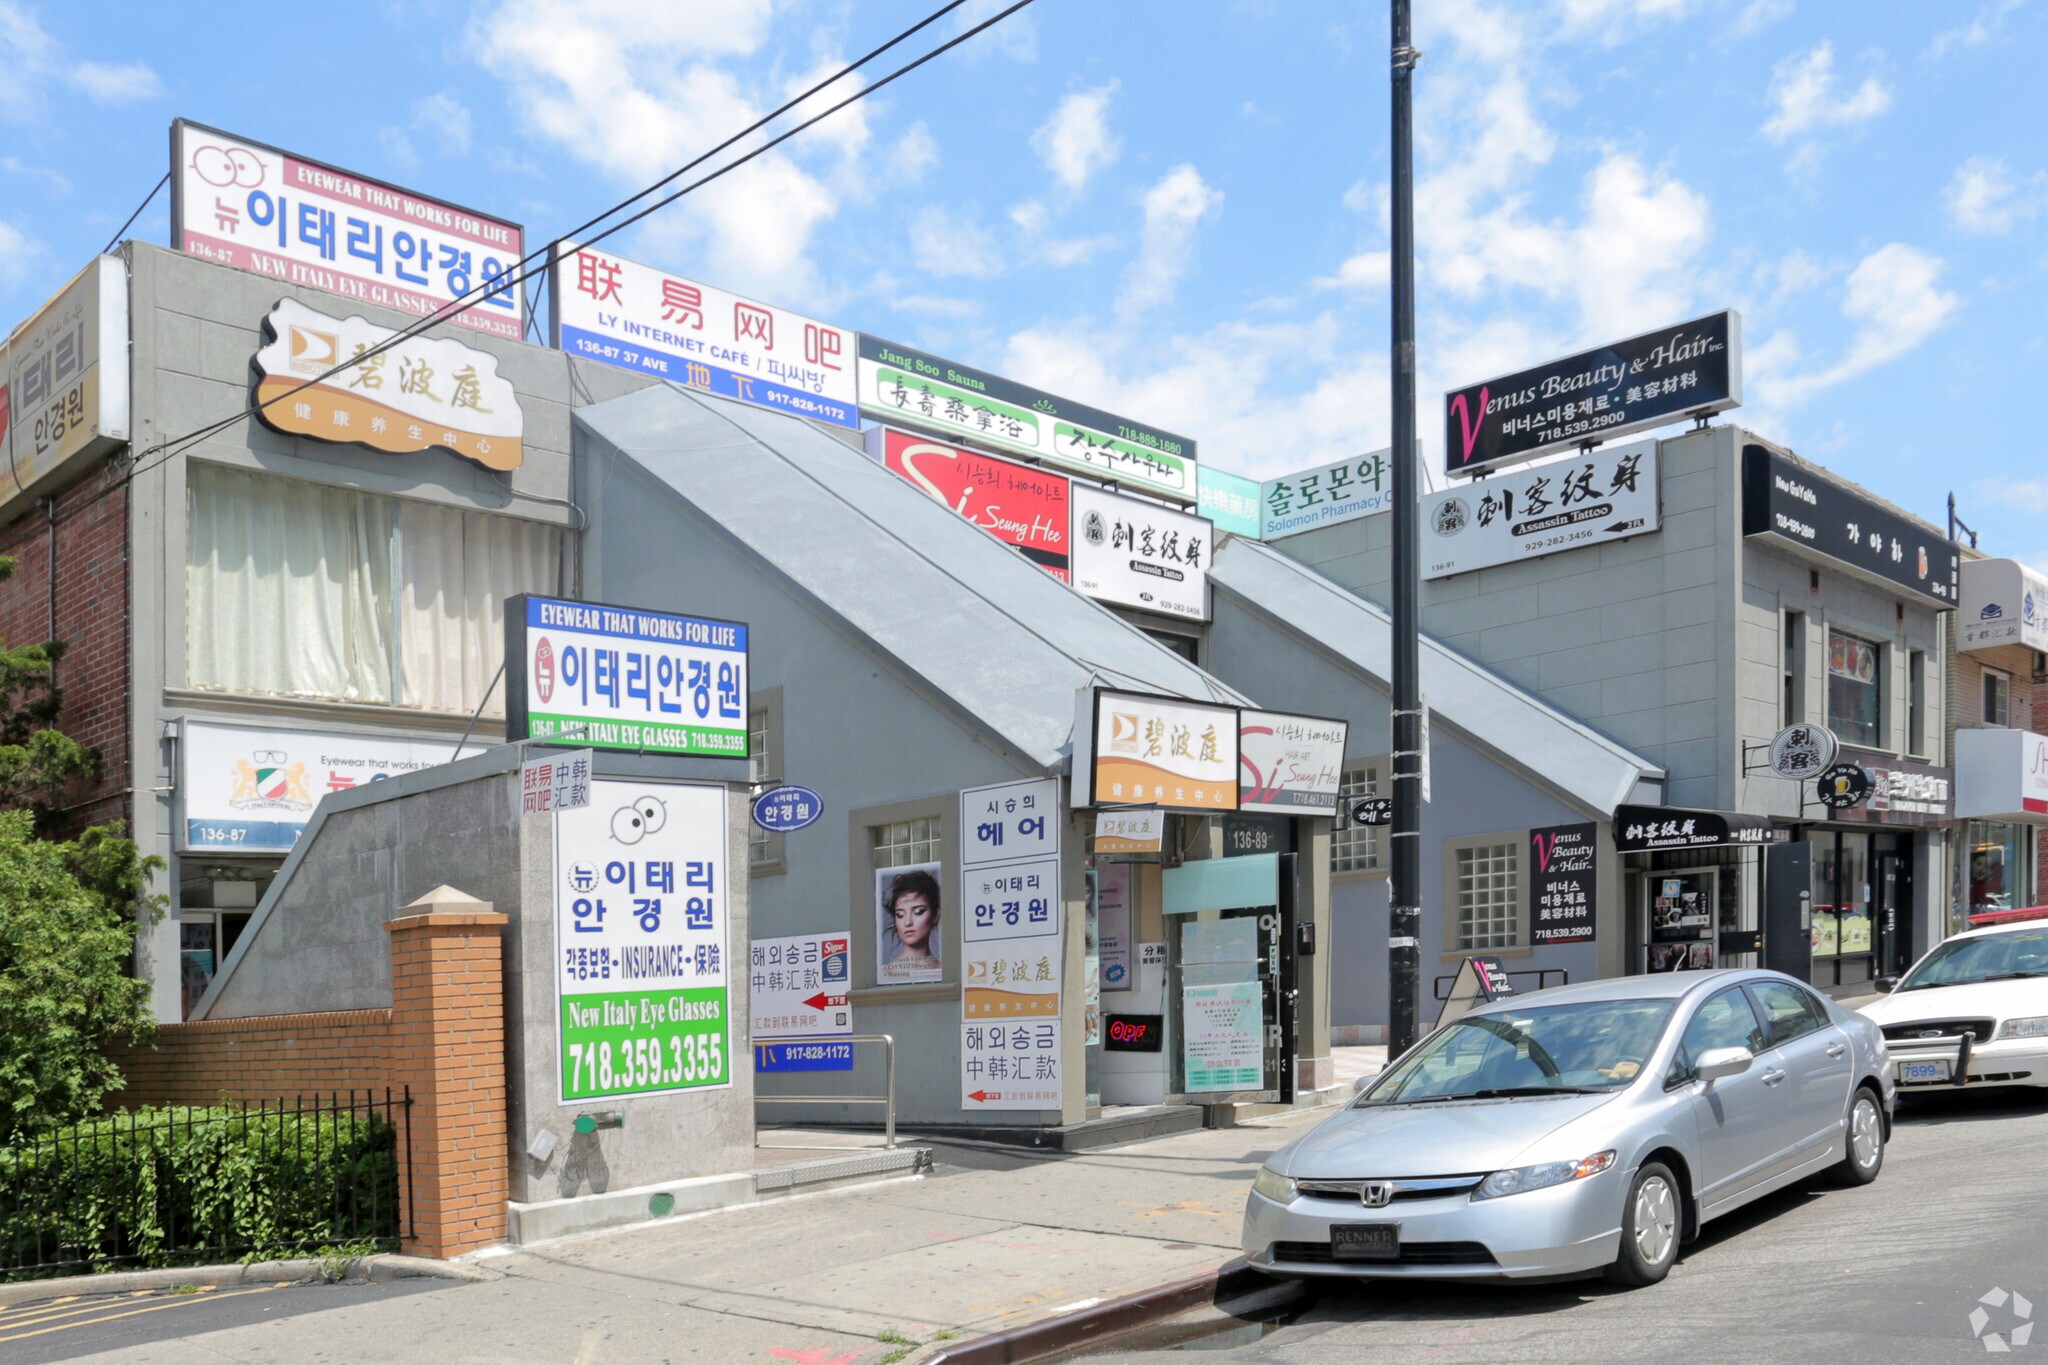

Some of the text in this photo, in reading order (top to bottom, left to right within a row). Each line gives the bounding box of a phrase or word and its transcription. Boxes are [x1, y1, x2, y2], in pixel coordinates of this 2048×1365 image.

[298, 165, 508, 244] EYEWEAR THAT WORKS FOR LIFE
[247, 190, 515, 310] 이태리안경원
[189, 240, 233, 263] 136-87
[250, 252, 287, 276] NEW
[292, 265, 335, 291] ITALY
[340, 277, 367, 299] EYE
[371, 286, 438, 320] GLASSES
[577, 250, 842, 371] 联易网吧
[598, 312, 618, 328] LY
[623, 319, 705, 352] INTERNET
[576, 339, 668, 373] 136-87 37 AVE
[879, 348, 985, 391] Jang Soo Sauna
[350, 342, 493, 414] 碧波庭
[767, 390, 845, 420] 917-828-1172
[1450, 386, 1536, 464] Venus
[1541, 362, 1626, 399] Beauty
[1650, 333, 1714, 368] Hair
[35, 382, 84, 456] 안경원
[1538, 411, 1625, 443] 718.539.2900
[1118, 425, 1181, 455] 718-888-1680
[1268, 455, 1392, 517] 솔로몬약
[979, 505, 1028, 542] Seung
[1030, 514, 1061, 543] Hee
[1267, 511, 1319, 533] Solomon
[1321, 495, 1382, 519] Pharmacy
[1518, 506, 1609, 535] Assassin Tattoo
[1525, 529, 1593, 551] 929-282-3456
[1133, 561, 1183, 581] Assassin Tattoo
[1431, 561, 1455, 572] 136-91
[541, 604, 736, 647] EYEWEAR THAT WORKS FOR LIFE
[561, 645, 741, 719] 이태리안경원
[560, 719, 588, 741] NEW
[589, 722, 619, 744] ITALY
[621, 725, 641, 745] EYE
[643, 727, 687, 748] GLASSES
[691, 732, 744, 751] 718.359.3355
[1142, 716, 1224, 763] 碧波庭
[321, 755, 365, 768] Eyewear
[368, 758, 389, 769] that
[391, 761, 417, 770] works
[1284, 763, 1338, 789] Seung Hee
[765, 803, 809, 823] 안경원
[987, 795, 1035, 815] 시승희
[1365, 801, 1391, 810] 시승
[200, 828, 246, 841] 136-87
[977, 816, 1046, 846] 헤어
[1233, 830, 1268, 849] 136-89
[1647, 835, 1718, 847] Assassin Tattoo
[1533, 832, 1581, 873] Venus
[1552, 846, 1593, 860] Beauty
[1559, 857, 1588, 872] Hair
[605, 861, 714, 894] 이태리
[994, 874, 1040, 893] 이태리
[1547, 881, 1580, 894] 비너스
[974, 898, 1049, 928] 안경원
[1540, 906, 1587, 920] 美容材料
[1541, 893, 1586, 907] 미용재료
[572, 898, 714, 933] 안경원
[1535, 927, 1592, 939] 718.539.2900
[566, 948, 610, 981] 각종보험
[622, 944, 684, 980] INSURANCE
[752, 942, 818, 967] 해외송금
[752, 968, 820, 993] 中韩汇款
[991, 956, 1057, 986] 碧波庭
[568, 996, 719, 1031] New Italy Eye Glasses
[786, 1046, 850, 1060] 917-828-1172
[966, 1025, 1056, 1051] 해외송금
[569, 1032, 722, 1093] 718.359.3355
[966, 1054, 1056, 1081] 中韩汇款
[1904, 1065, 1936, 1077] 7899
[1335, 1231, 1391, 1242] RENNER
